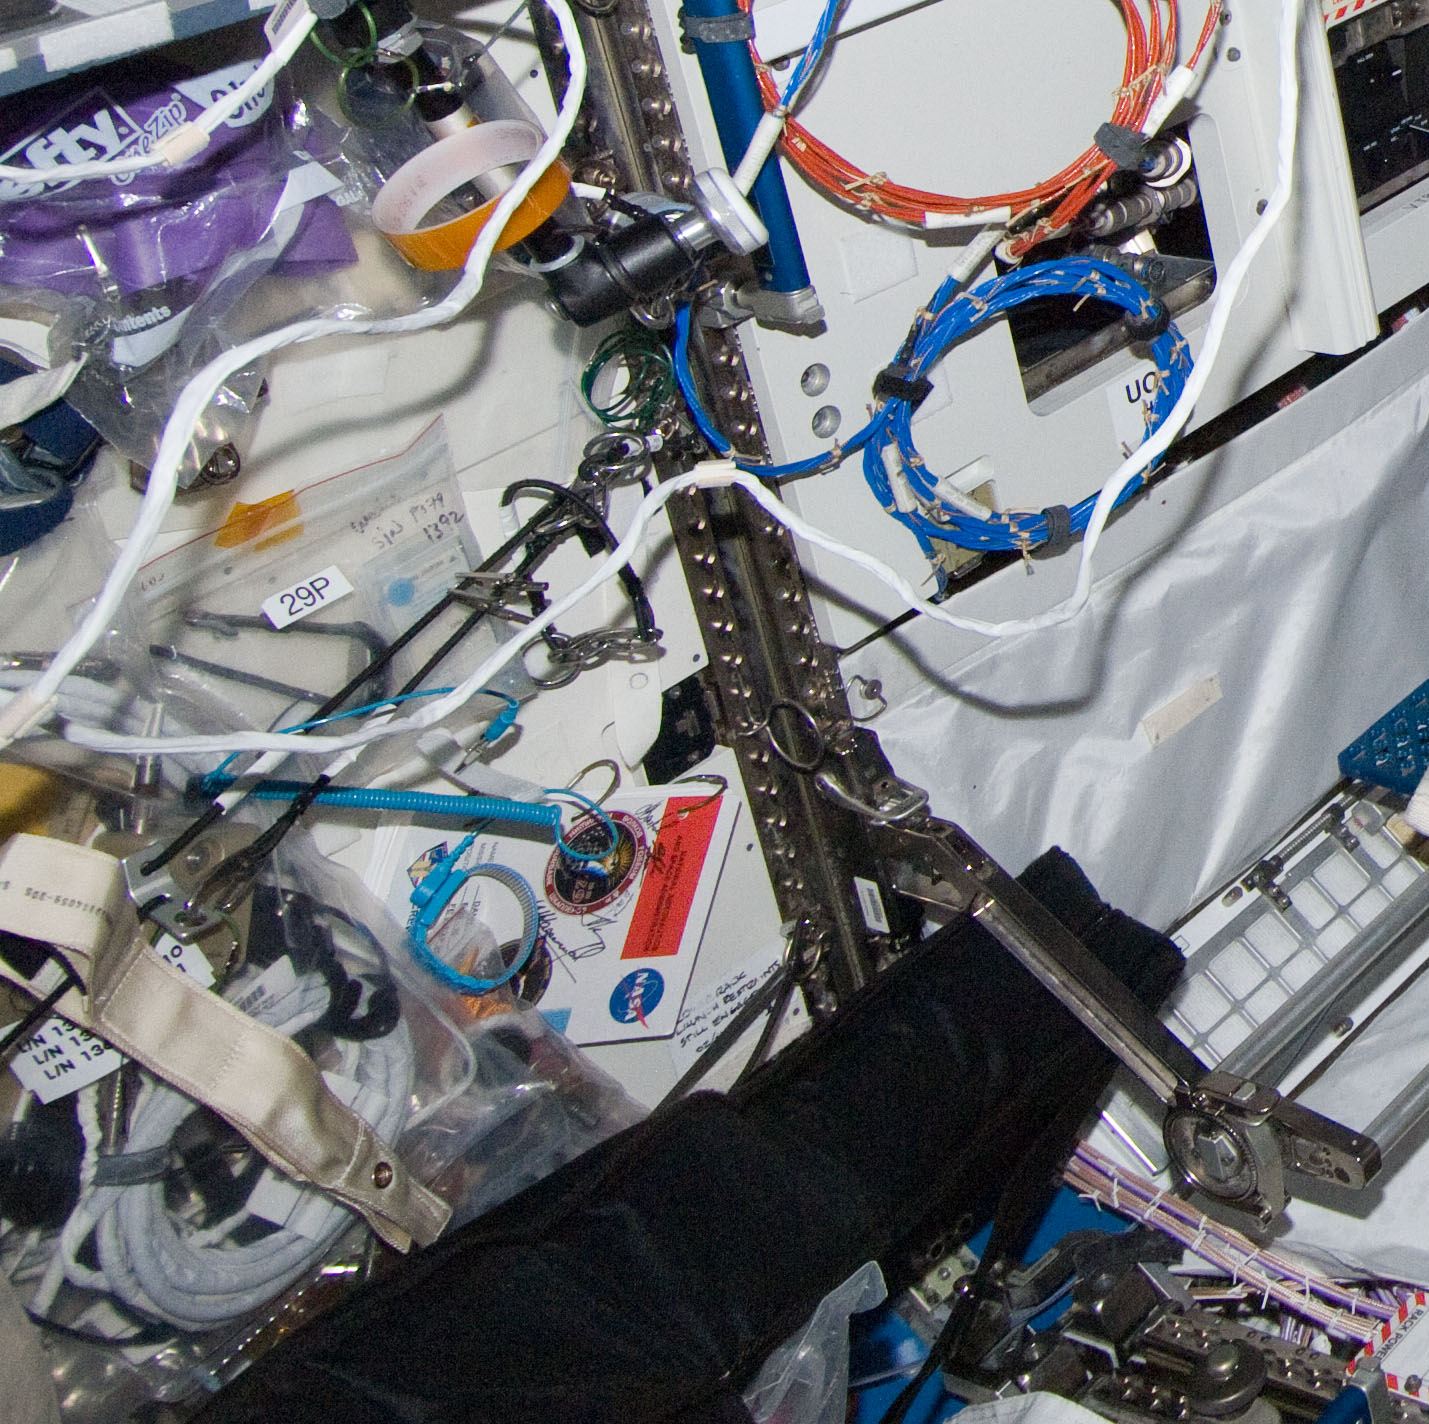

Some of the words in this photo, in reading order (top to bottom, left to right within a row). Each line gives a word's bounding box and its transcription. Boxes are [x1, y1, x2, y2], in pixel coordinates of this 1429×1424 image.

[279, 576, 331, 617] 29P
[622, 971, 651, 1022] NASA
[32, 1044, 65, 1066] L/N
[43, 1059, 76, 1081] L/N
[1398, 1307, 1425, 1335] RACK
